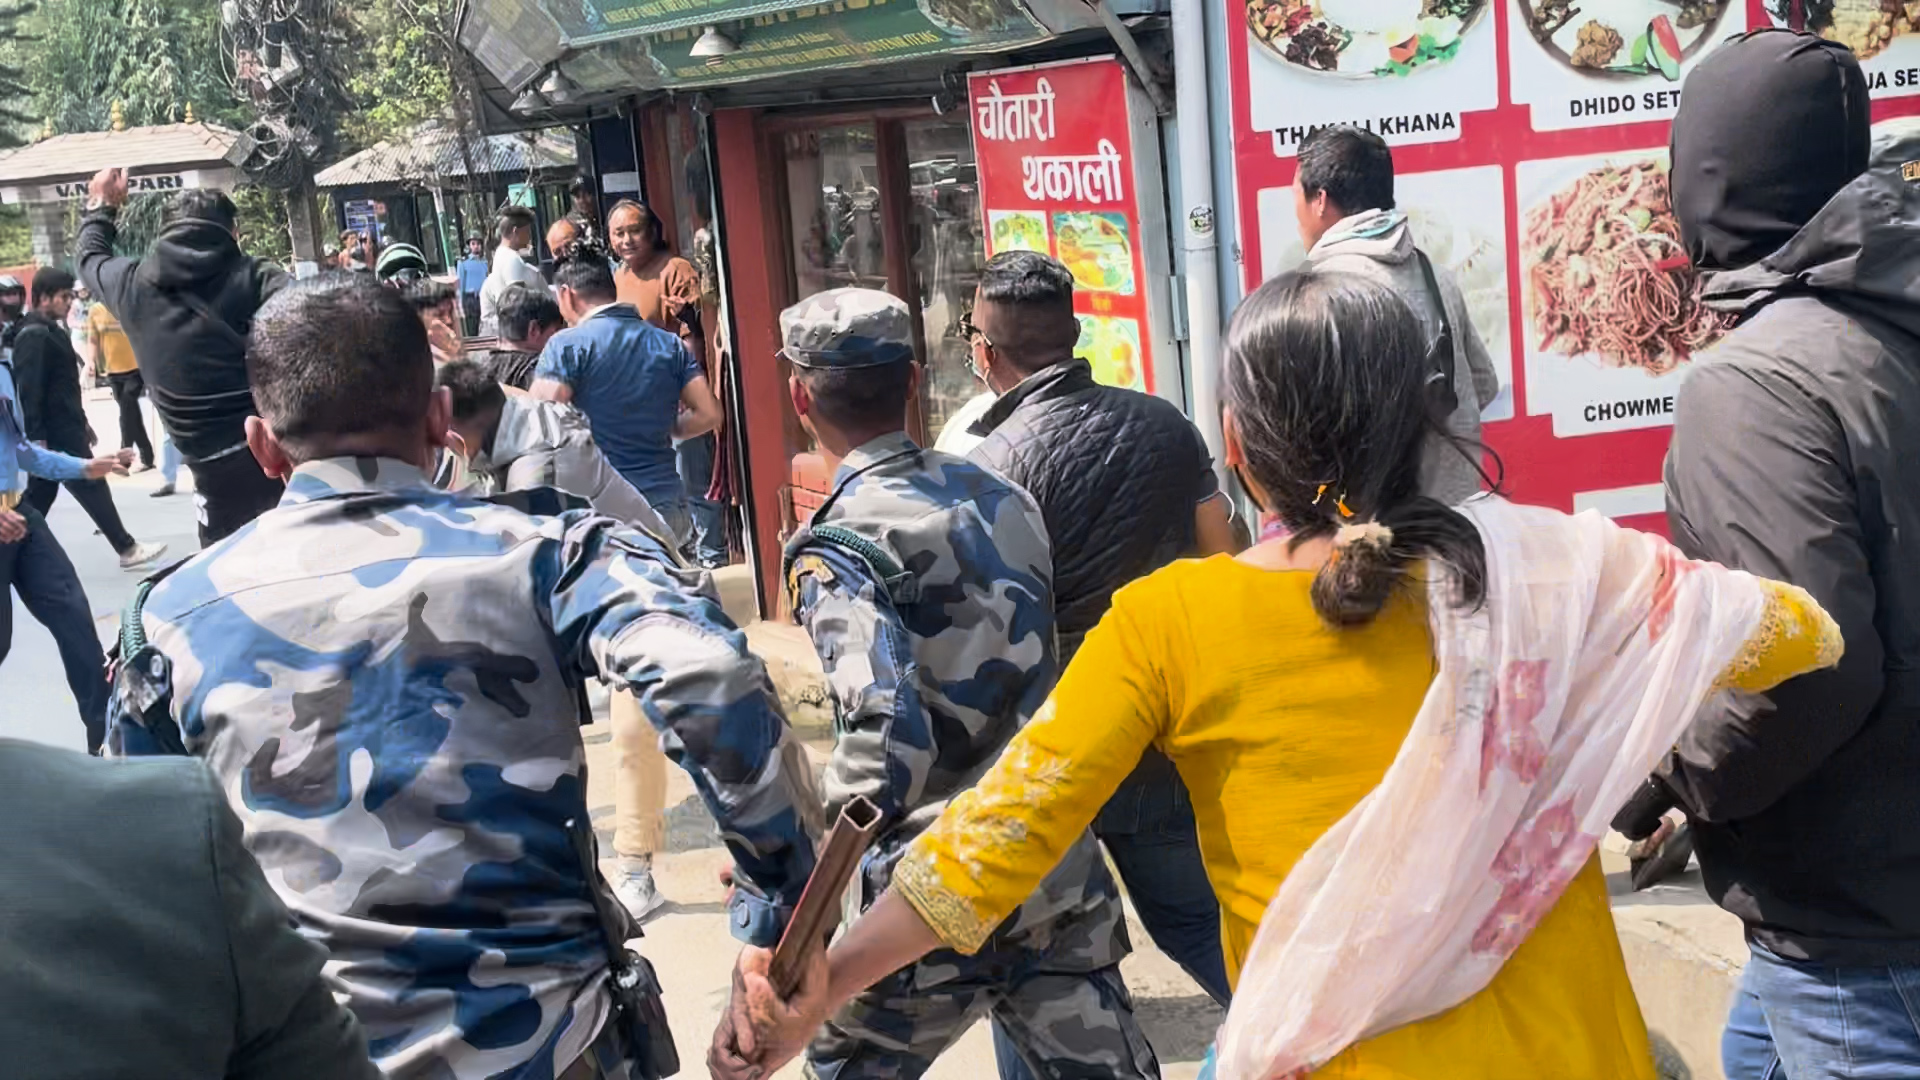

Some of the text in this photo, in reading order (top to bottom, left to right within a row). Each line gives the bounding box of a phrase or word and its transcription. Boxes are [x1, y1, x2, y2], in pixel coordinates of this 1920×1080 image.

[1868, 67, 1920, 90] JA SE
[977, 77, 1055, 142] चौतारी
[1570, 89, 1681, 117] DHIDO SET
[1379, 111, 1456, 136] KHANA
[1021, 138, 1123, 204] थकाली
[1583, 395, 1674, 422] CHOWME
